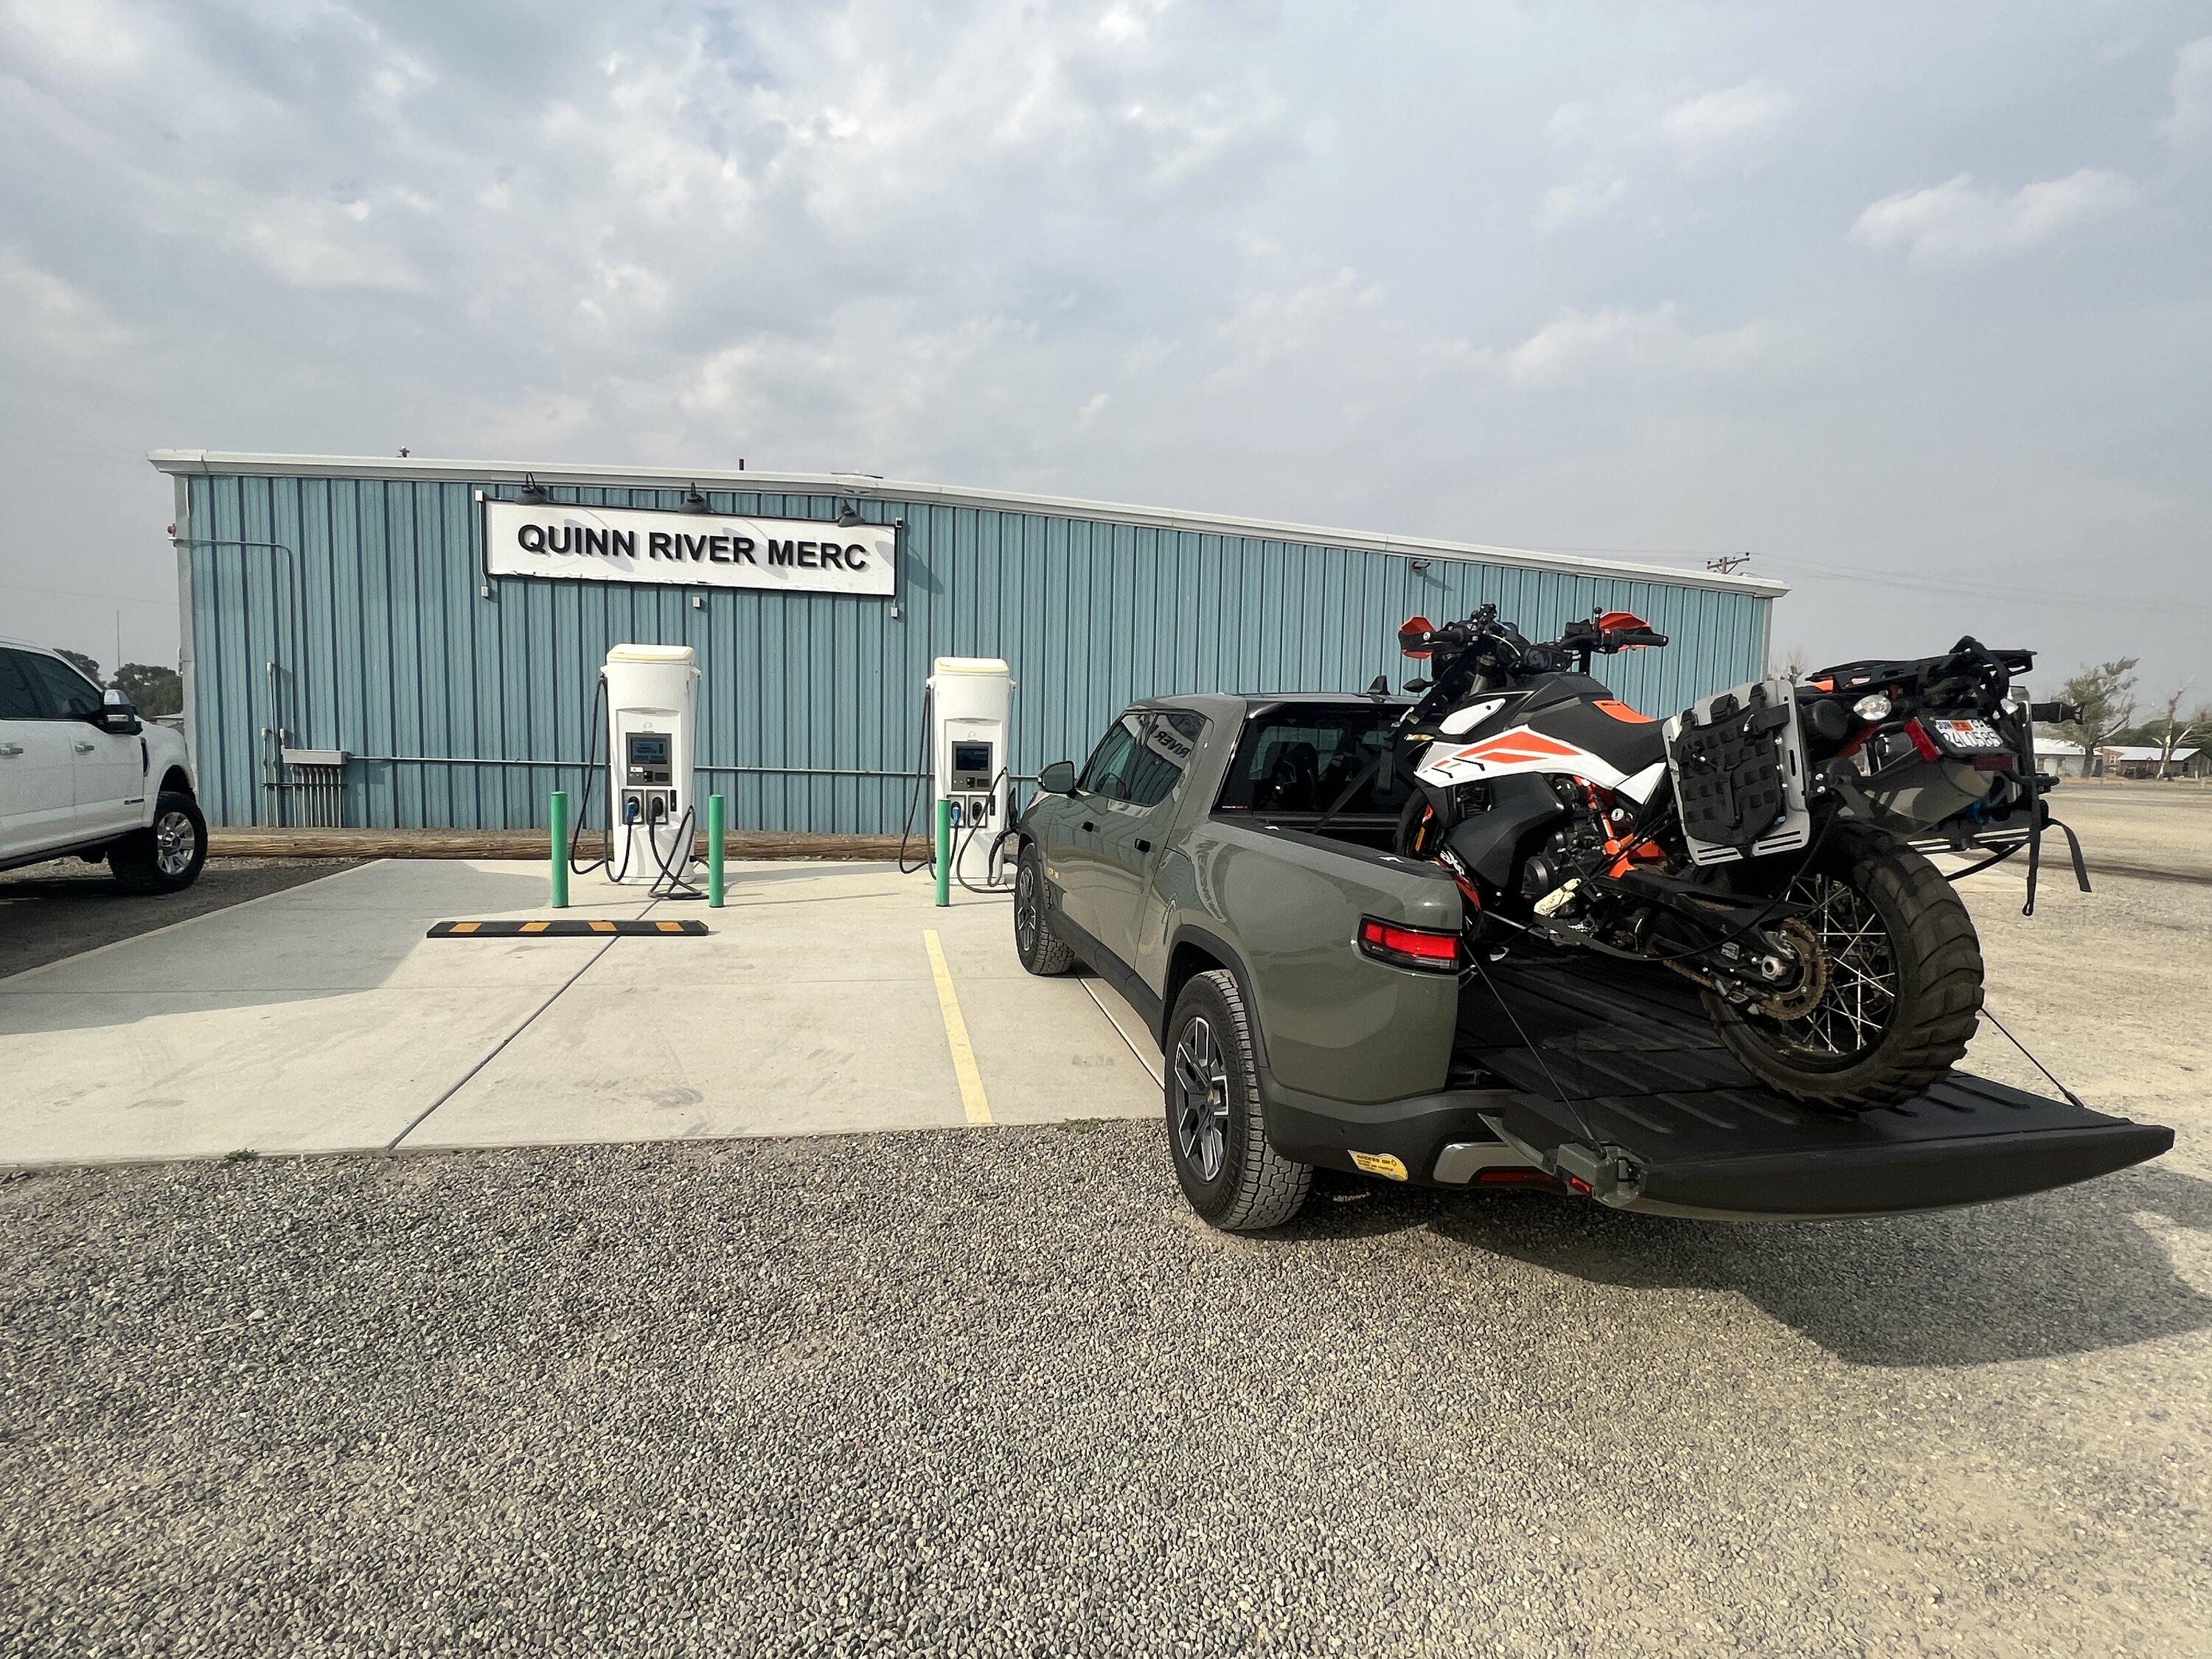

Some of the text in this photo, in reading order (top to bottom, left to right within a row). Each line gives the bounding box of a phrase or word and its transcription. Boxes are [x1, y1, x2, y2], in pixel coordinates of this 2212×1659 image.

[518, 524, 866, 570] QUINN RIVER MERC
